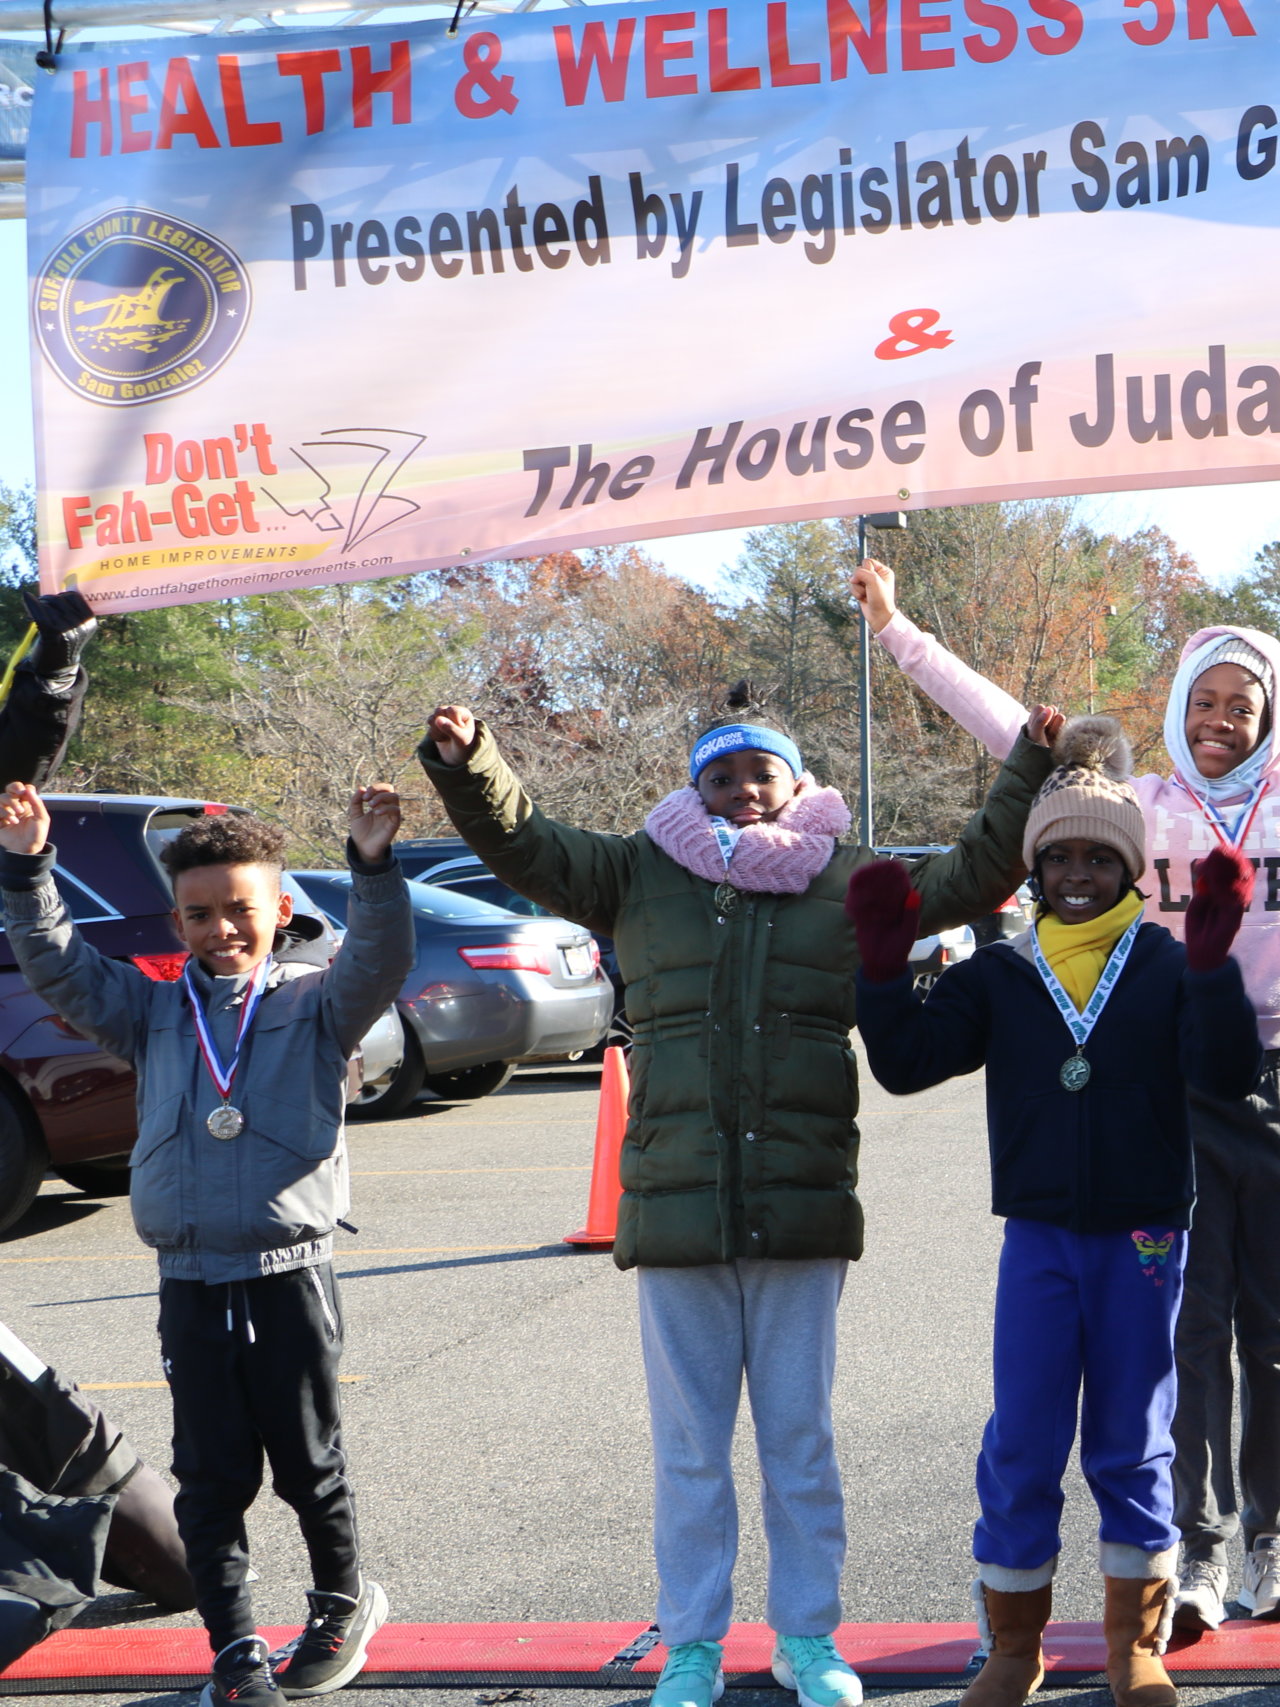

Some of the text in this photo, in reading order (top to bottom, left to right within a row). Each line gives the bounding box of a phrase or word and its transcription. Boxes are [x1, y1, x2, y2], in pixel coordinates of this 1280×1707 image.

[69, 40, 412, 159] HEALTH
[454, 31, 519, 118] &
[552, 0, 1084, 107] WELLNESS
[290, 175, 611, 291] Presented
[629, 172, 703, 278] by
[725, 135, 1047, 265] Legislator
[1069, 121, 1210, 213] Sam
[39, 216, 242, 312] SUFFOLK COUNTY LEGISLATOR
[874, 308, 955, 360] &
[78, 358, 206, 399] Sam Gonzalez
[144, 422, 278, 485] Don't
[522, 442, 656, 518] The
[675, 399, 926, 490] House
[958, 360, 1042, 457] of
[84, 555, 393, 603] www.dontfahgethomeimprovements.com
[100, 546, 299, 571] HOME IMPROVEMENTS
[695, 731, 743, 767] HOKA ONE
[725, 737, 745, 748] ONE
